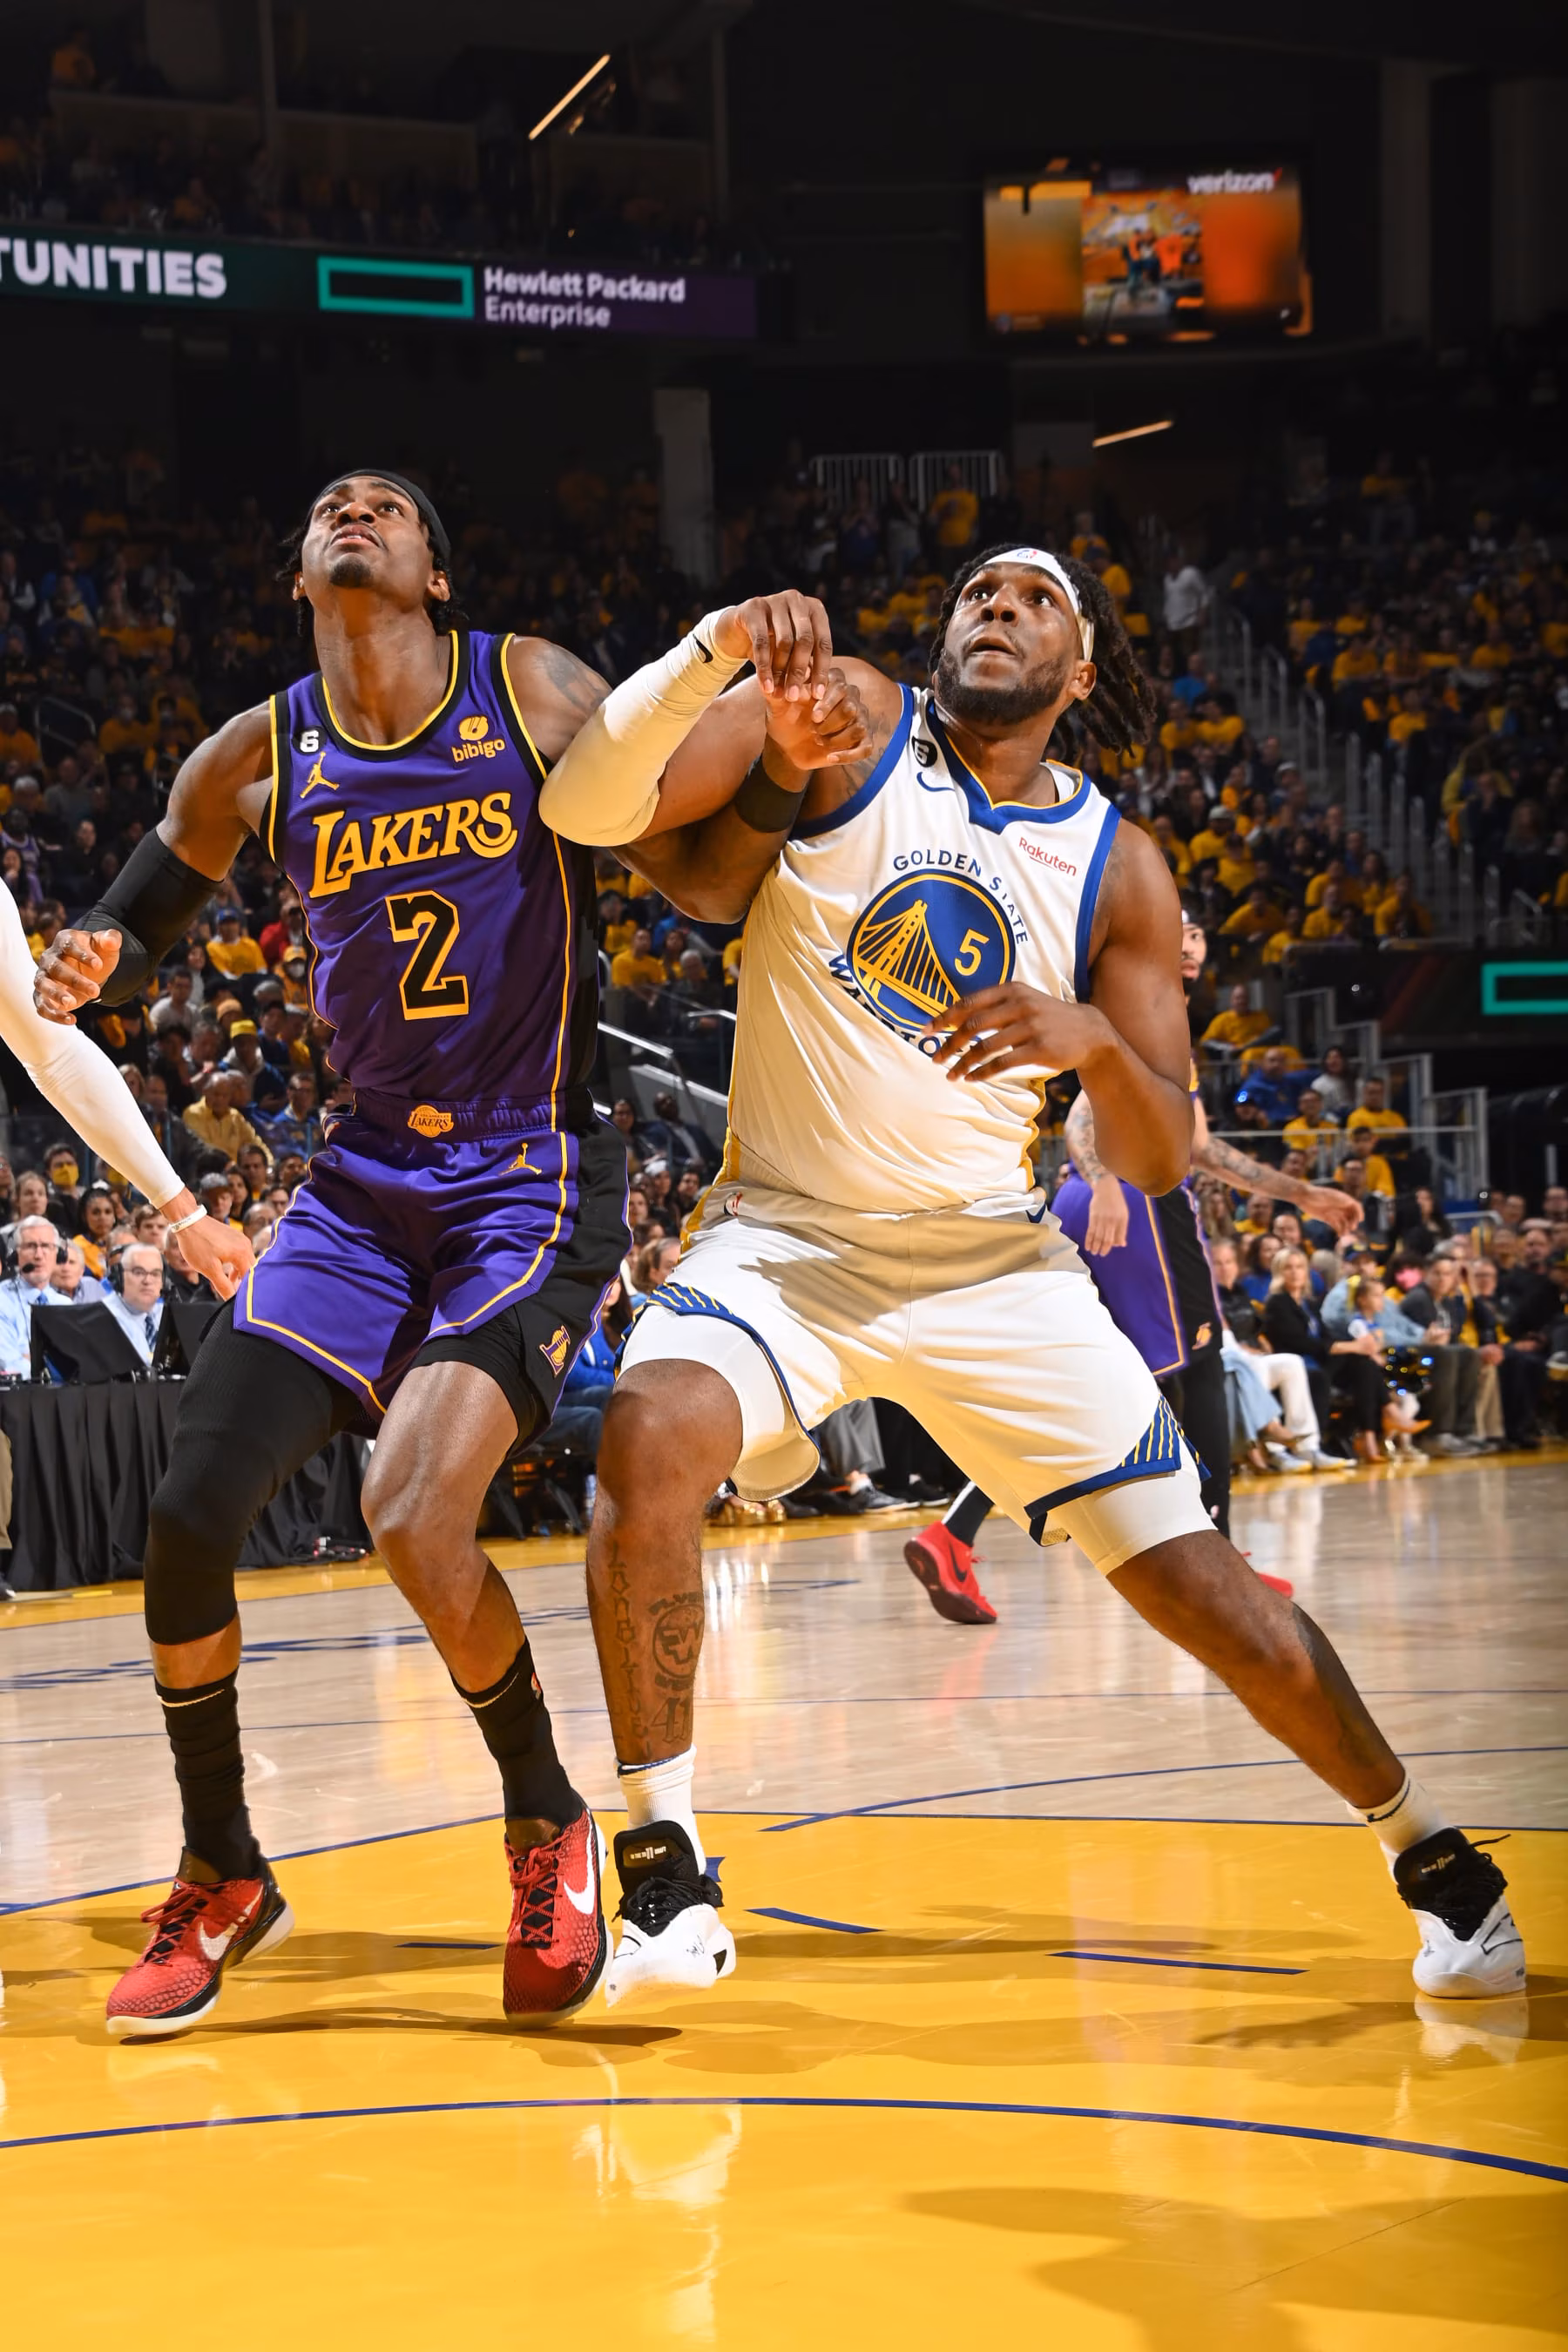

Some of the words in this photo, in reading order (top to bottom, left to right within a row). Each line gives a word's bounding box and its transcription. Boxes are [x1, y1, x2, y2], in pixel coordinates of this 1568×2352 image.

[1187, 169, 1274, 194] verizon
[484, 267, 583, 297] Hewlett
[586, 273, 686, 303] Packard
[484, 295, 611, 330] Enterprise
[300, 729, 319, 754] 6
[451, 737, 506, 763] bibigo
[309, 792, 518, 899] LAKERS
[893, 848, 982, 877] GOLDEN
[1018, 836, 1078, 876] Rakuten
[385, 890, 470, 1021] 2
[954, 929, 990, 977] 5
[410, 1112, 450, 1130] LAKERS
